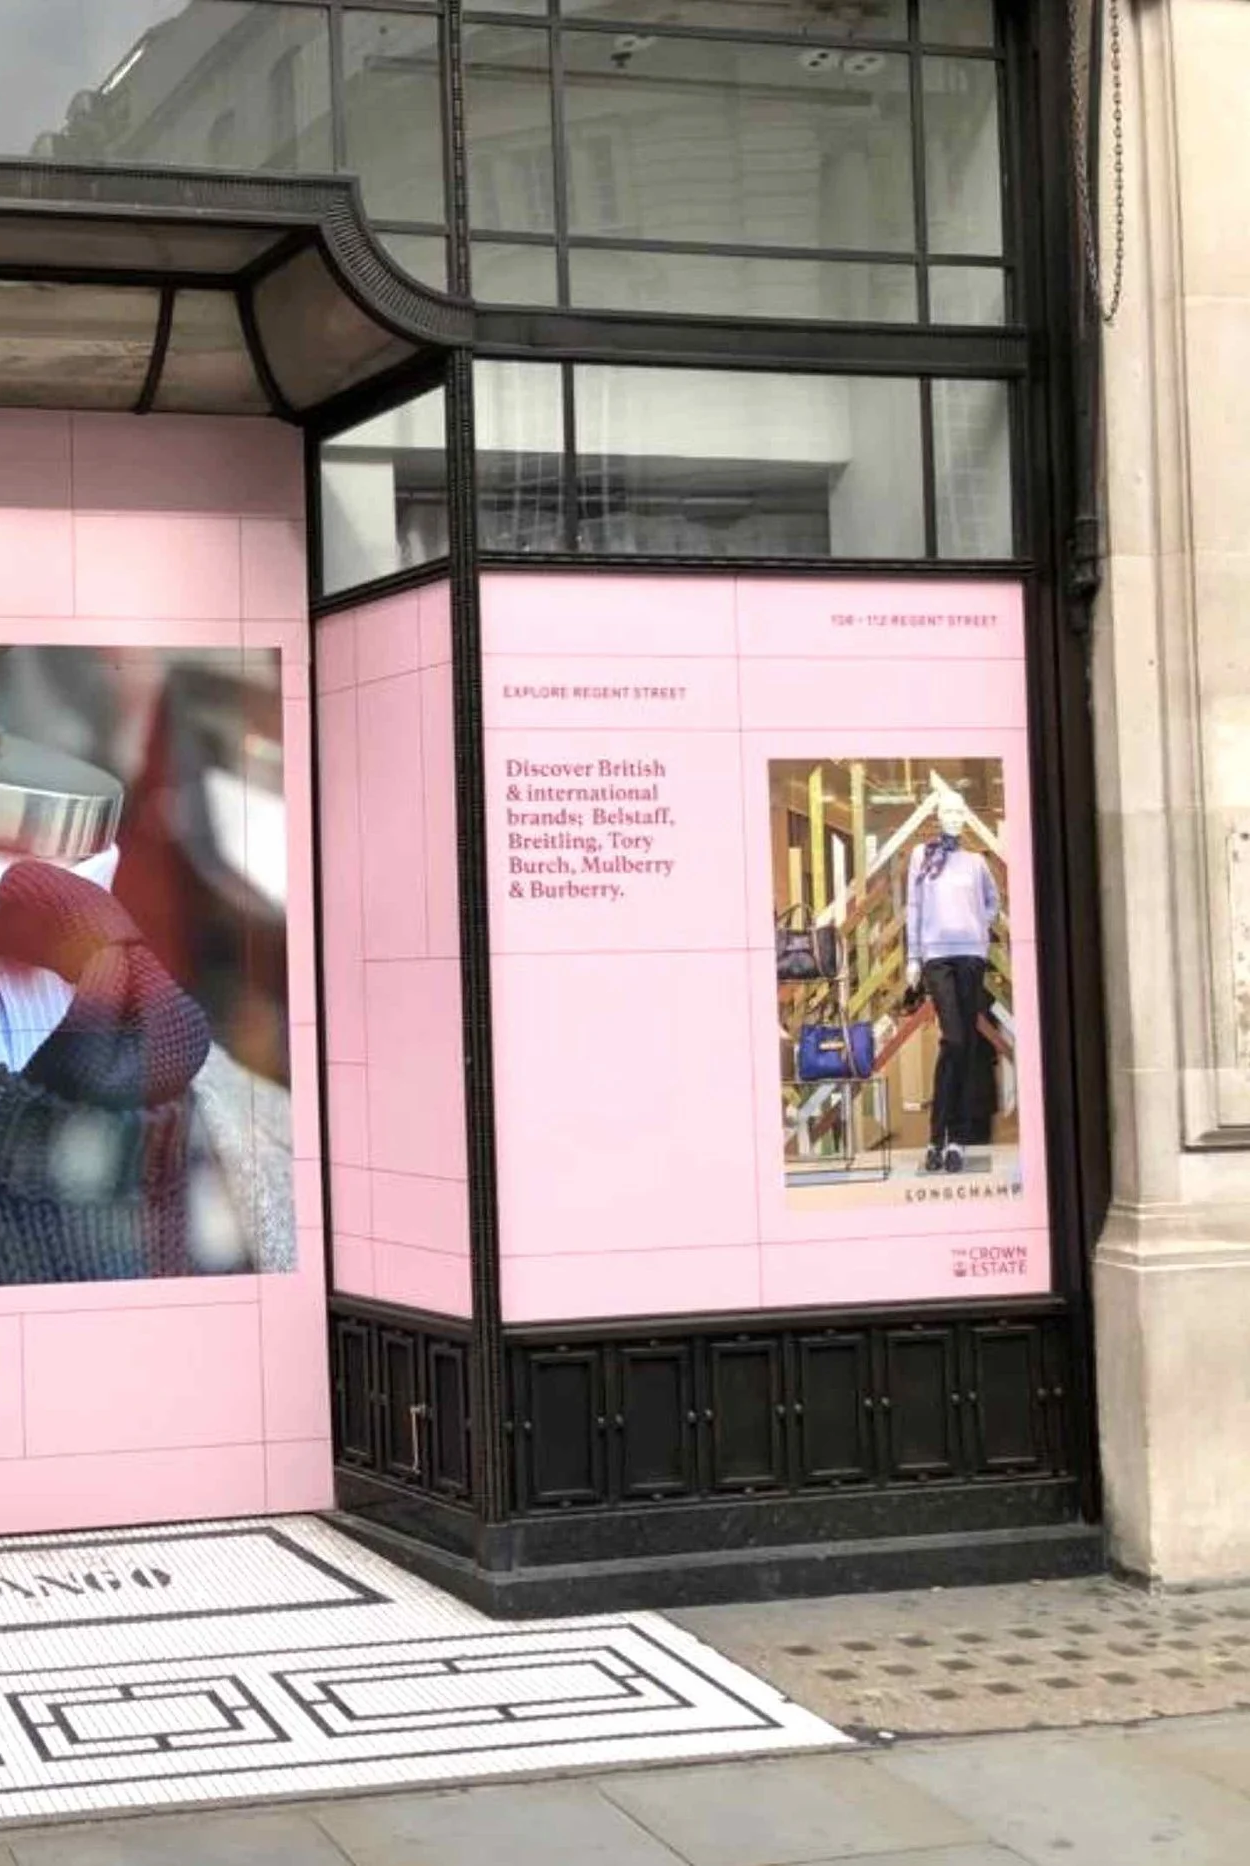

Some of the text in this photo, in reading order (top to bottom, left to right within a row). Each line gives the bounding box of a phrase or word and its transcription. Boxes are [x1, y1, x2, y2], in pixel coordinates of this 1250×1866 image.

[891, 614, 945, 627] REGENT
[947, 614, 999, 627] STREET
[503, 685, 687, 699] EXPLORE REGENT STREET
[506, 759, 666, 777] Discover British
[506, 784, 659, 801] & international
[507, 807, 676, 828] brands; Belstaff,
[508, 832, 653, 853] Breitling, Tory
[509, 856, 675, 877] Burch, Mulberry
[509, 880, 625, 901] & Burberry.
[905, 1183, 1023, 1202] LONGCHAMP
[969, 1247, 1028, 1260] CROWN
[971, 1260, 1028, 1277] ESTATE
